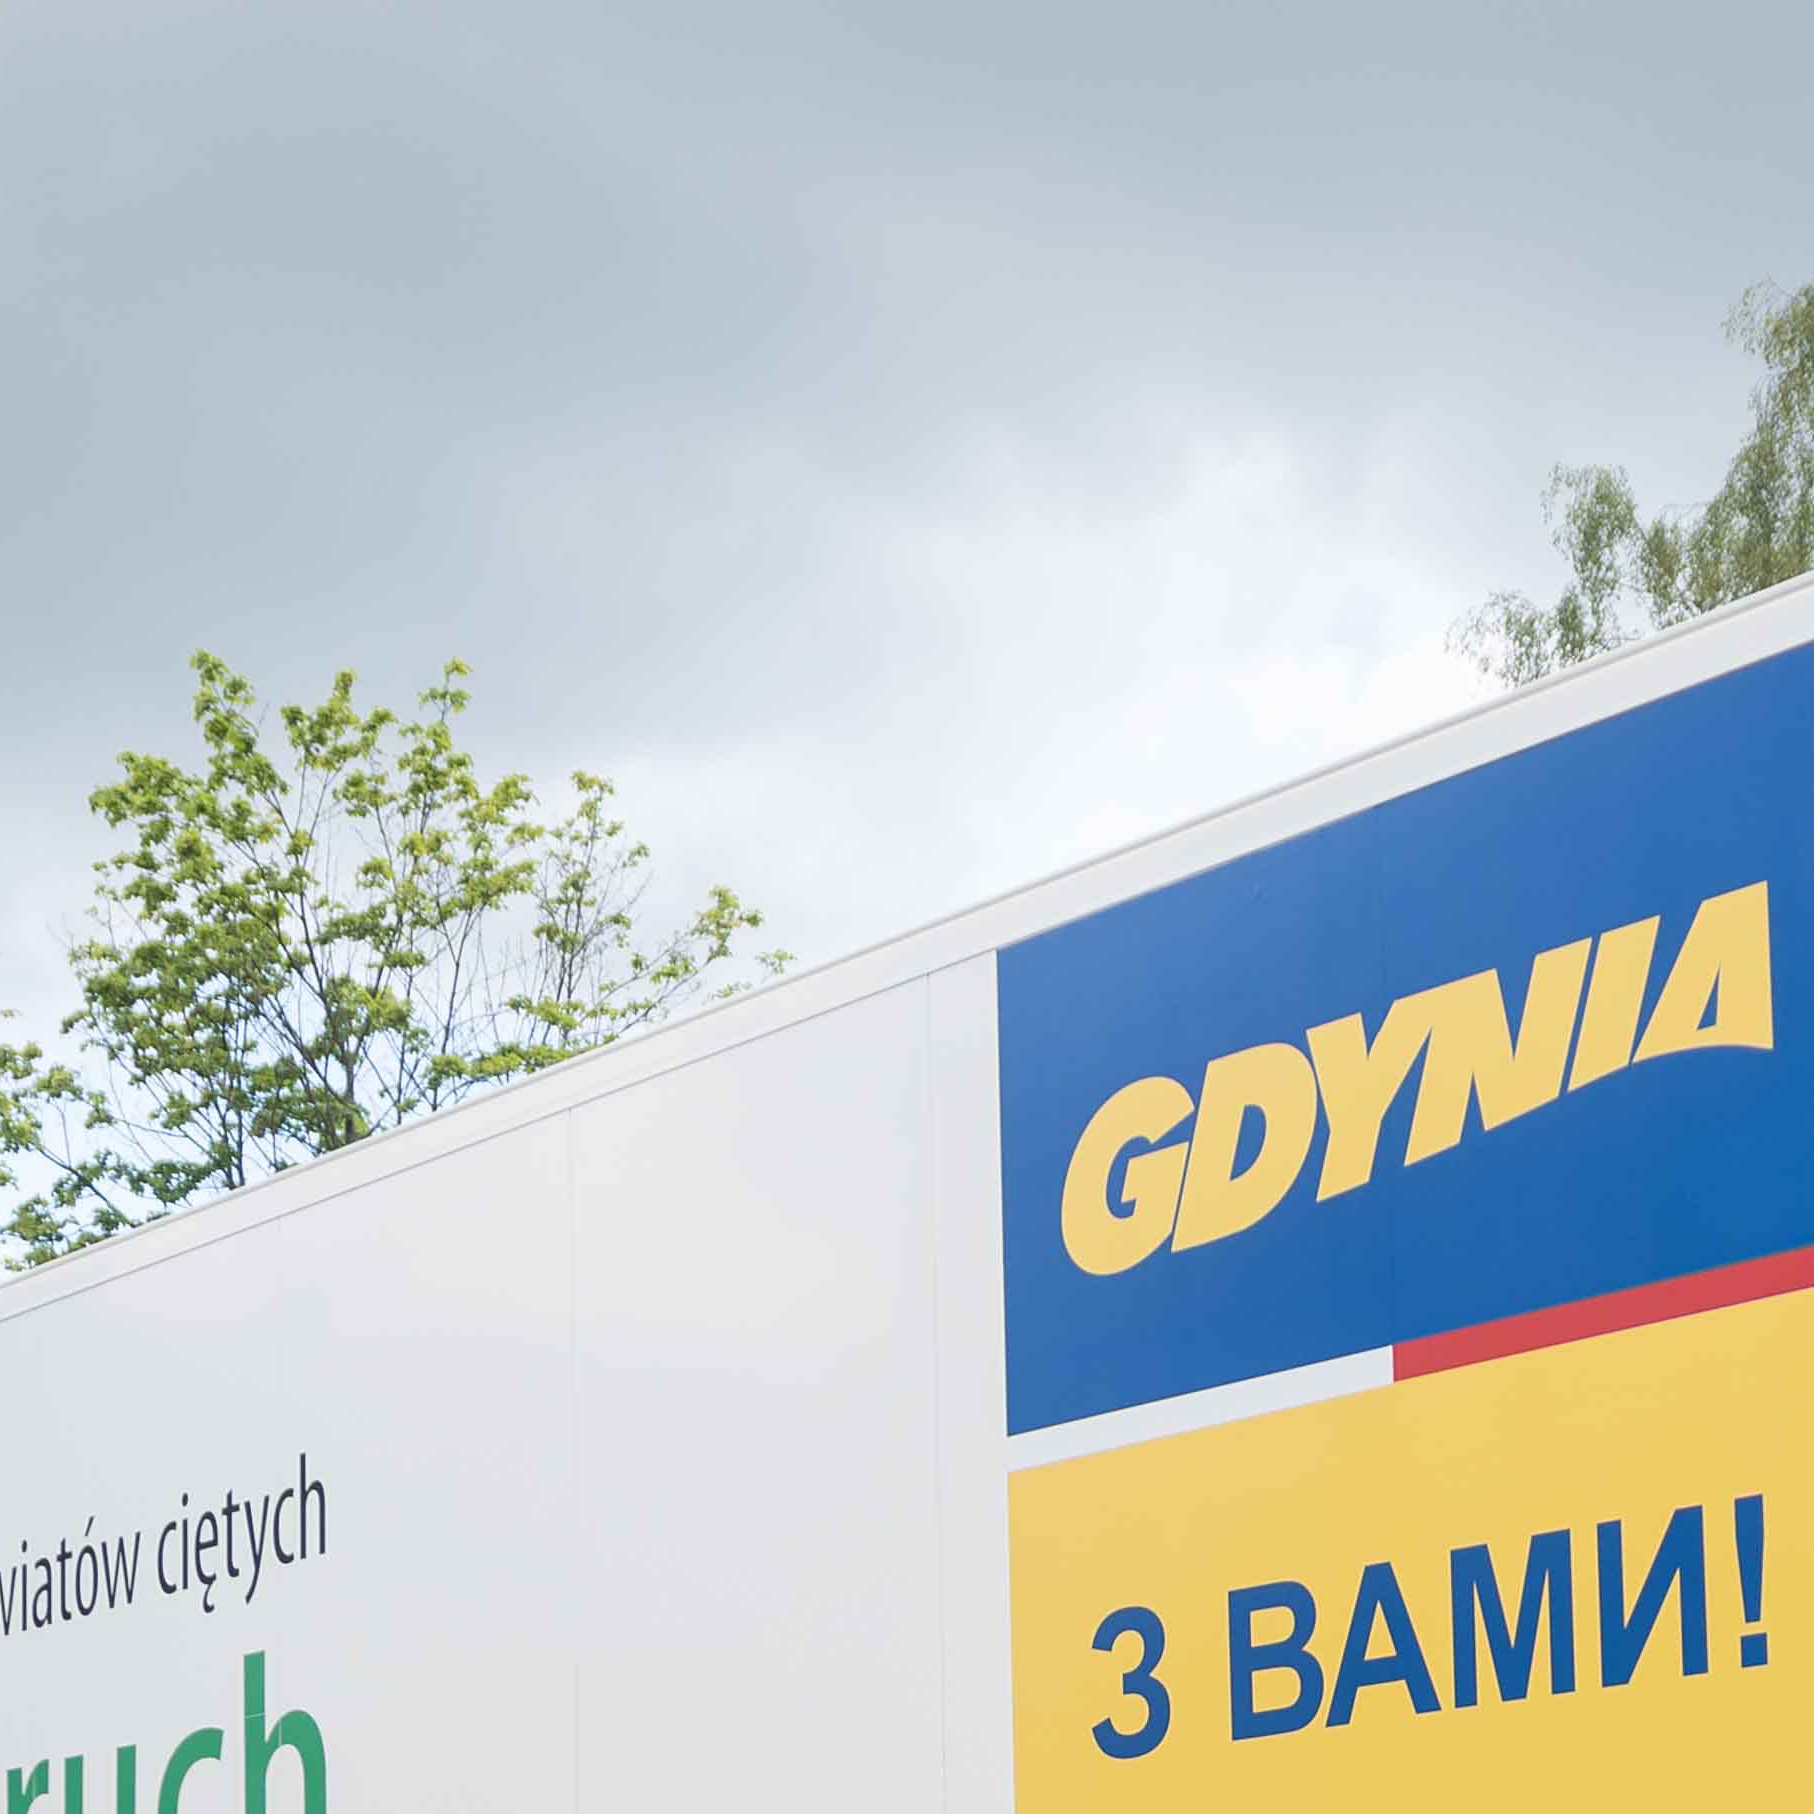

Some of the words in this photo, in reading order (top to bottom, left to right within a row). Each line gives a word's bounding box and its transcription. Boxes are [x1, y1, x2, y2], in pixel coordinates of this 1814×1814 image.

[1060, 880, 1773, 1276] GDYNIA
[157, 1452, 326, 1613] ciętych
[1228, 1493, 1770, 1741] ВАМИ!
